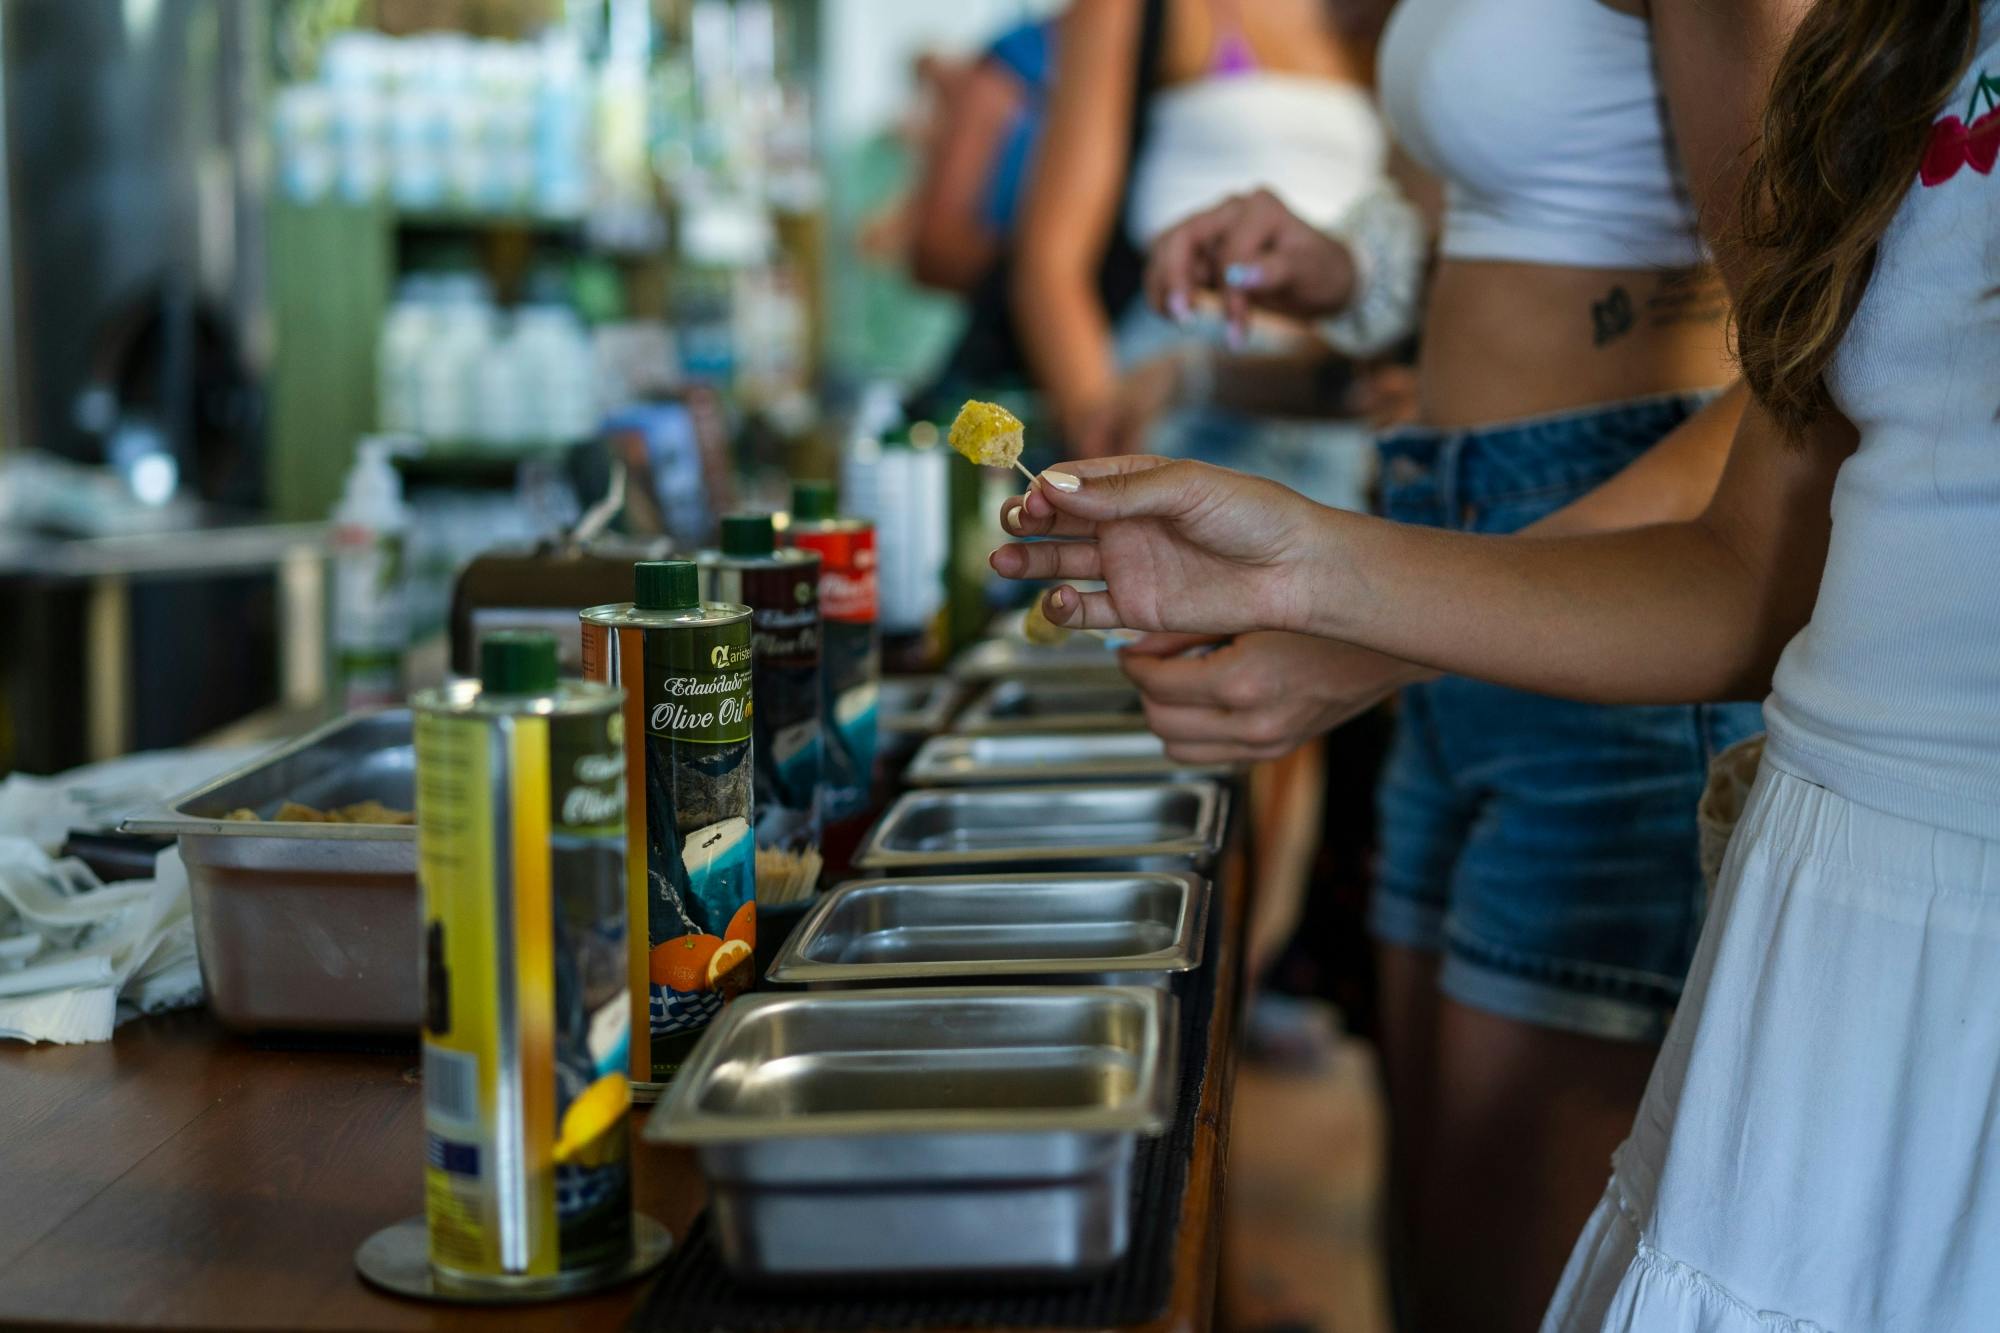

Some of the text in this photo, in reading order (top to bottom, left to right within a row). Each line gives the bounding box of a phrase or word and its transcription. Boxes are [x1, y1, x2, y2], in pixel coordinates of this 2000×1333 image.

[664, 672, 742, 697] Ελαιόλαδο
[651, 702, 714, 730] Olive
[719, 697, 744, 726] Oil
